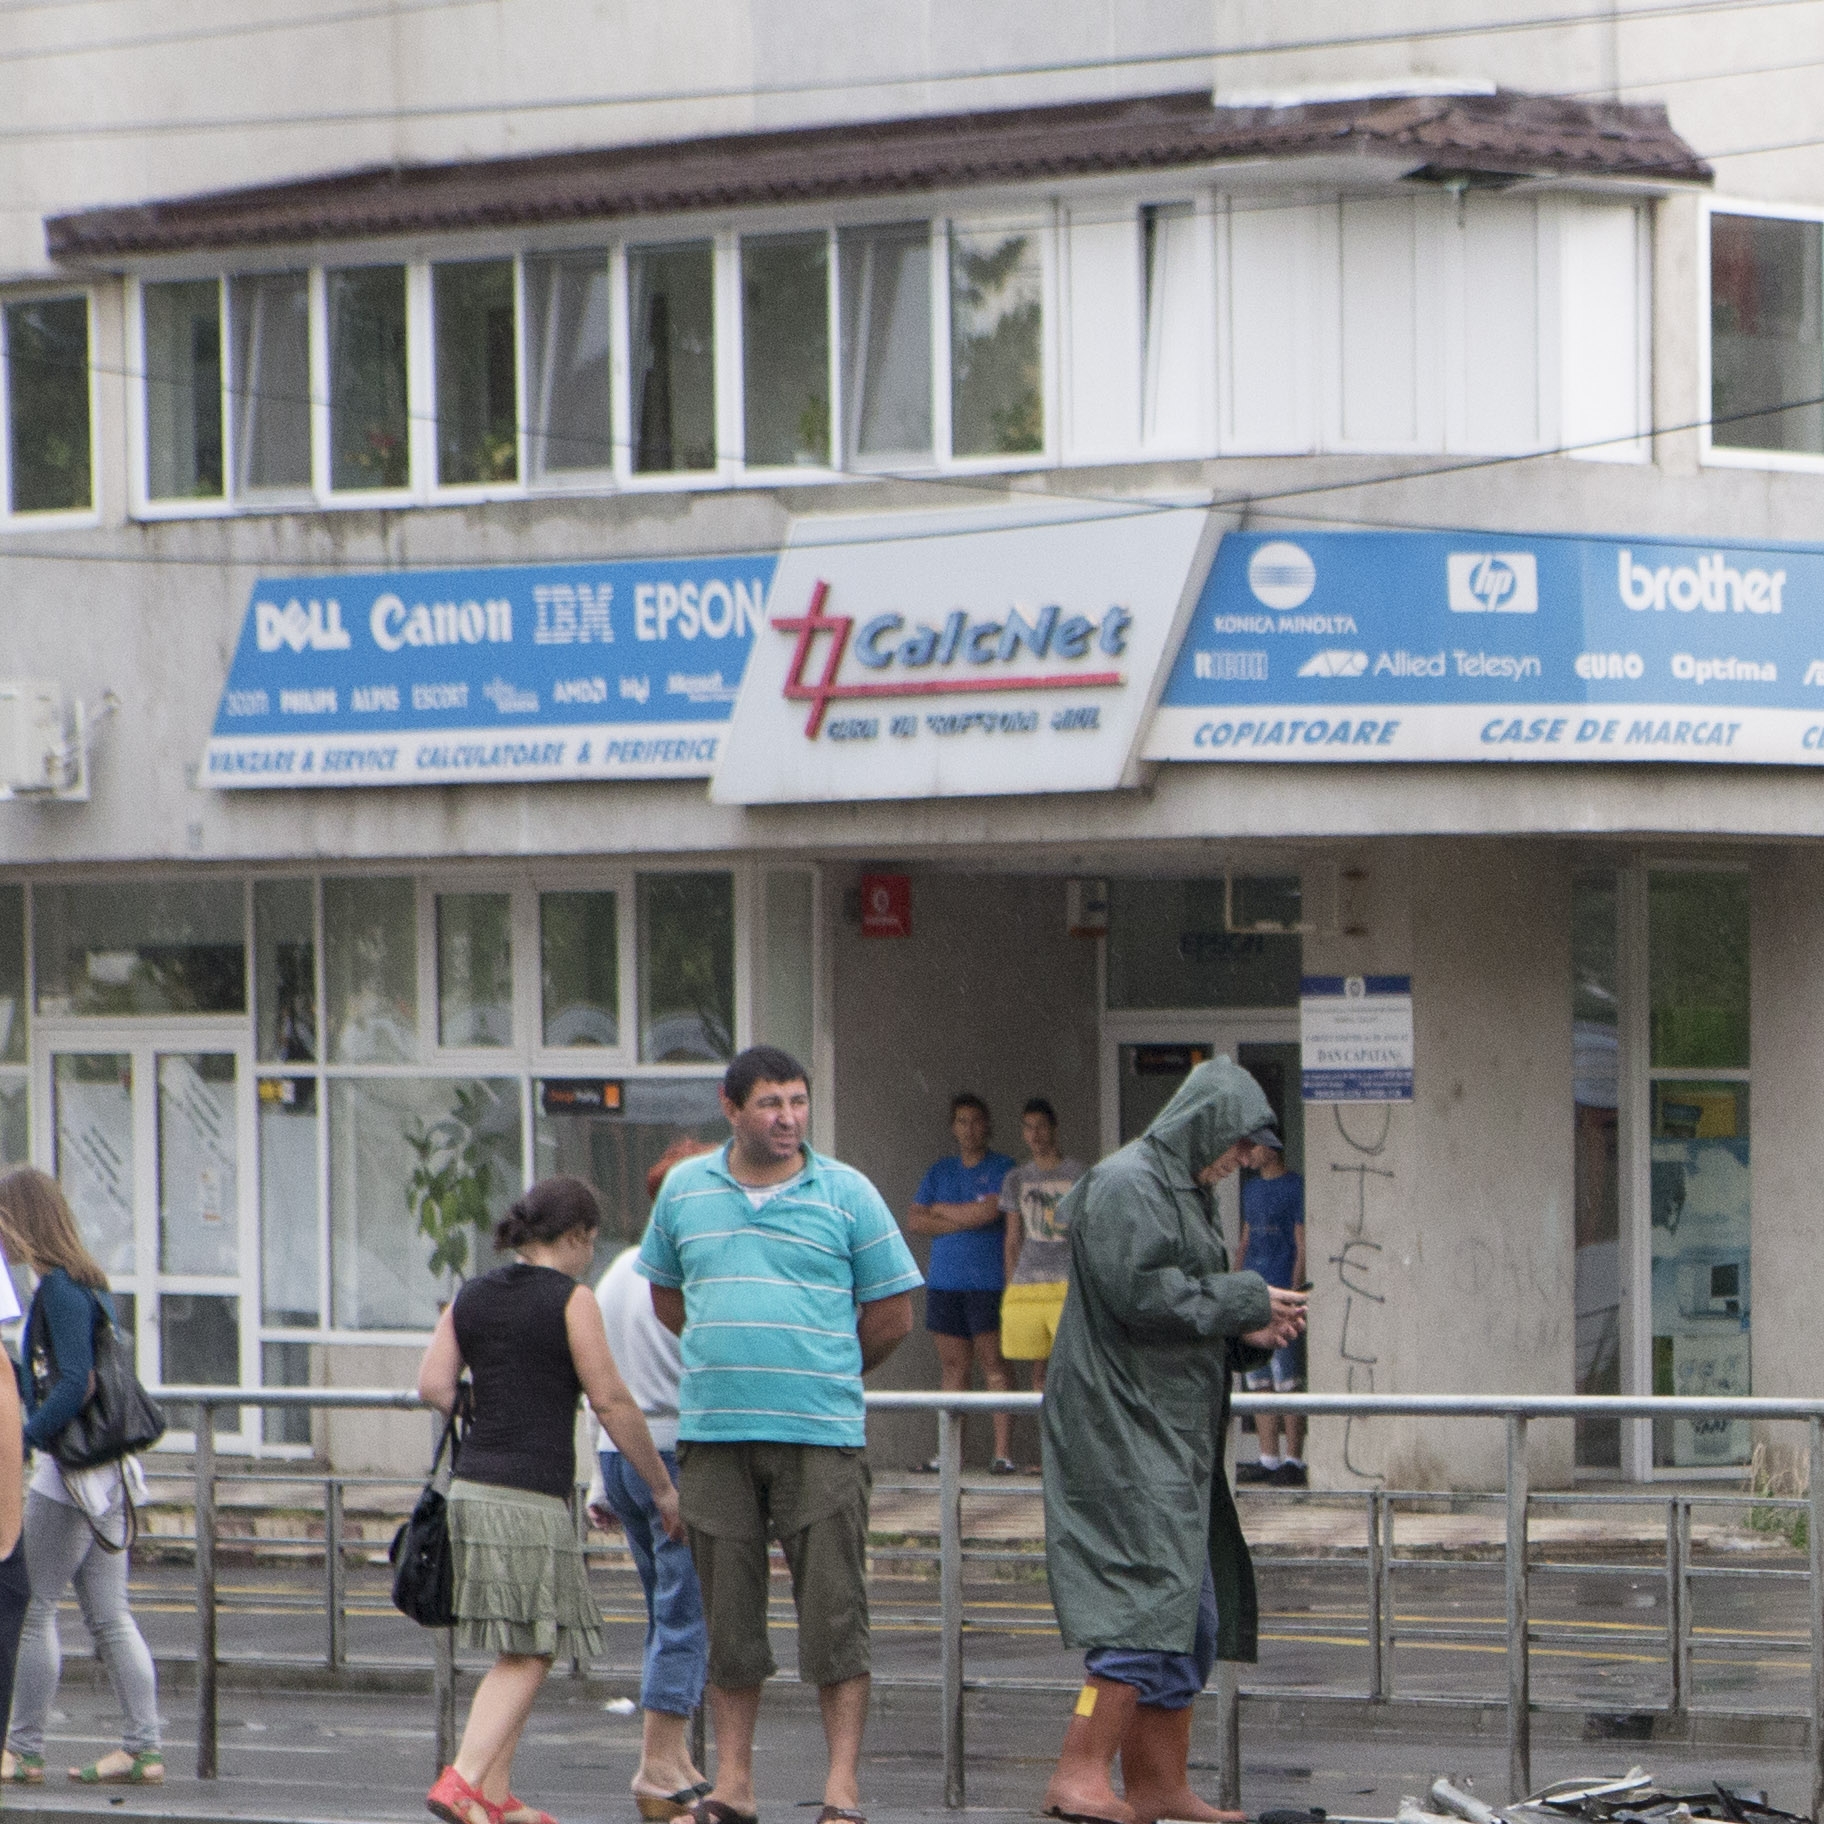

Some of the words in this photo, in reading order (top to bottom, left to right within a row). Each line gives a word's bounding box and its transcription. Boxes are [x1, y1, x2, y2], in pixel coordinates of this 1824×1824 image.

[1618, 549, 1786, 614] brother
[256, 599, 350, 653] DELL
[371, 592, 512, 652] Canon
[532, 584, 615, 645] IBM
[635, 578, 766, 642] EPSON
[1213, 615, 1275, 634] KONICA
[1277, 614, 1358, 634] MINOLTA
[854, 604, 1132, 668] CalcNet
[1372, 650, 1447, 677] Allied
[1453, 651, 1541, 681] Telesyn
[1193, 720, 1402, 748] COPIATOARE
[1480, 718, 1568, 745] CASE
[1574, 718, 1620, 745] DE
[1625, 719, 1742, 747] MARCAT
[416, 743, 565, 769] CALCULATOARE
[605, 738, 718, 763] PERIFERICE
